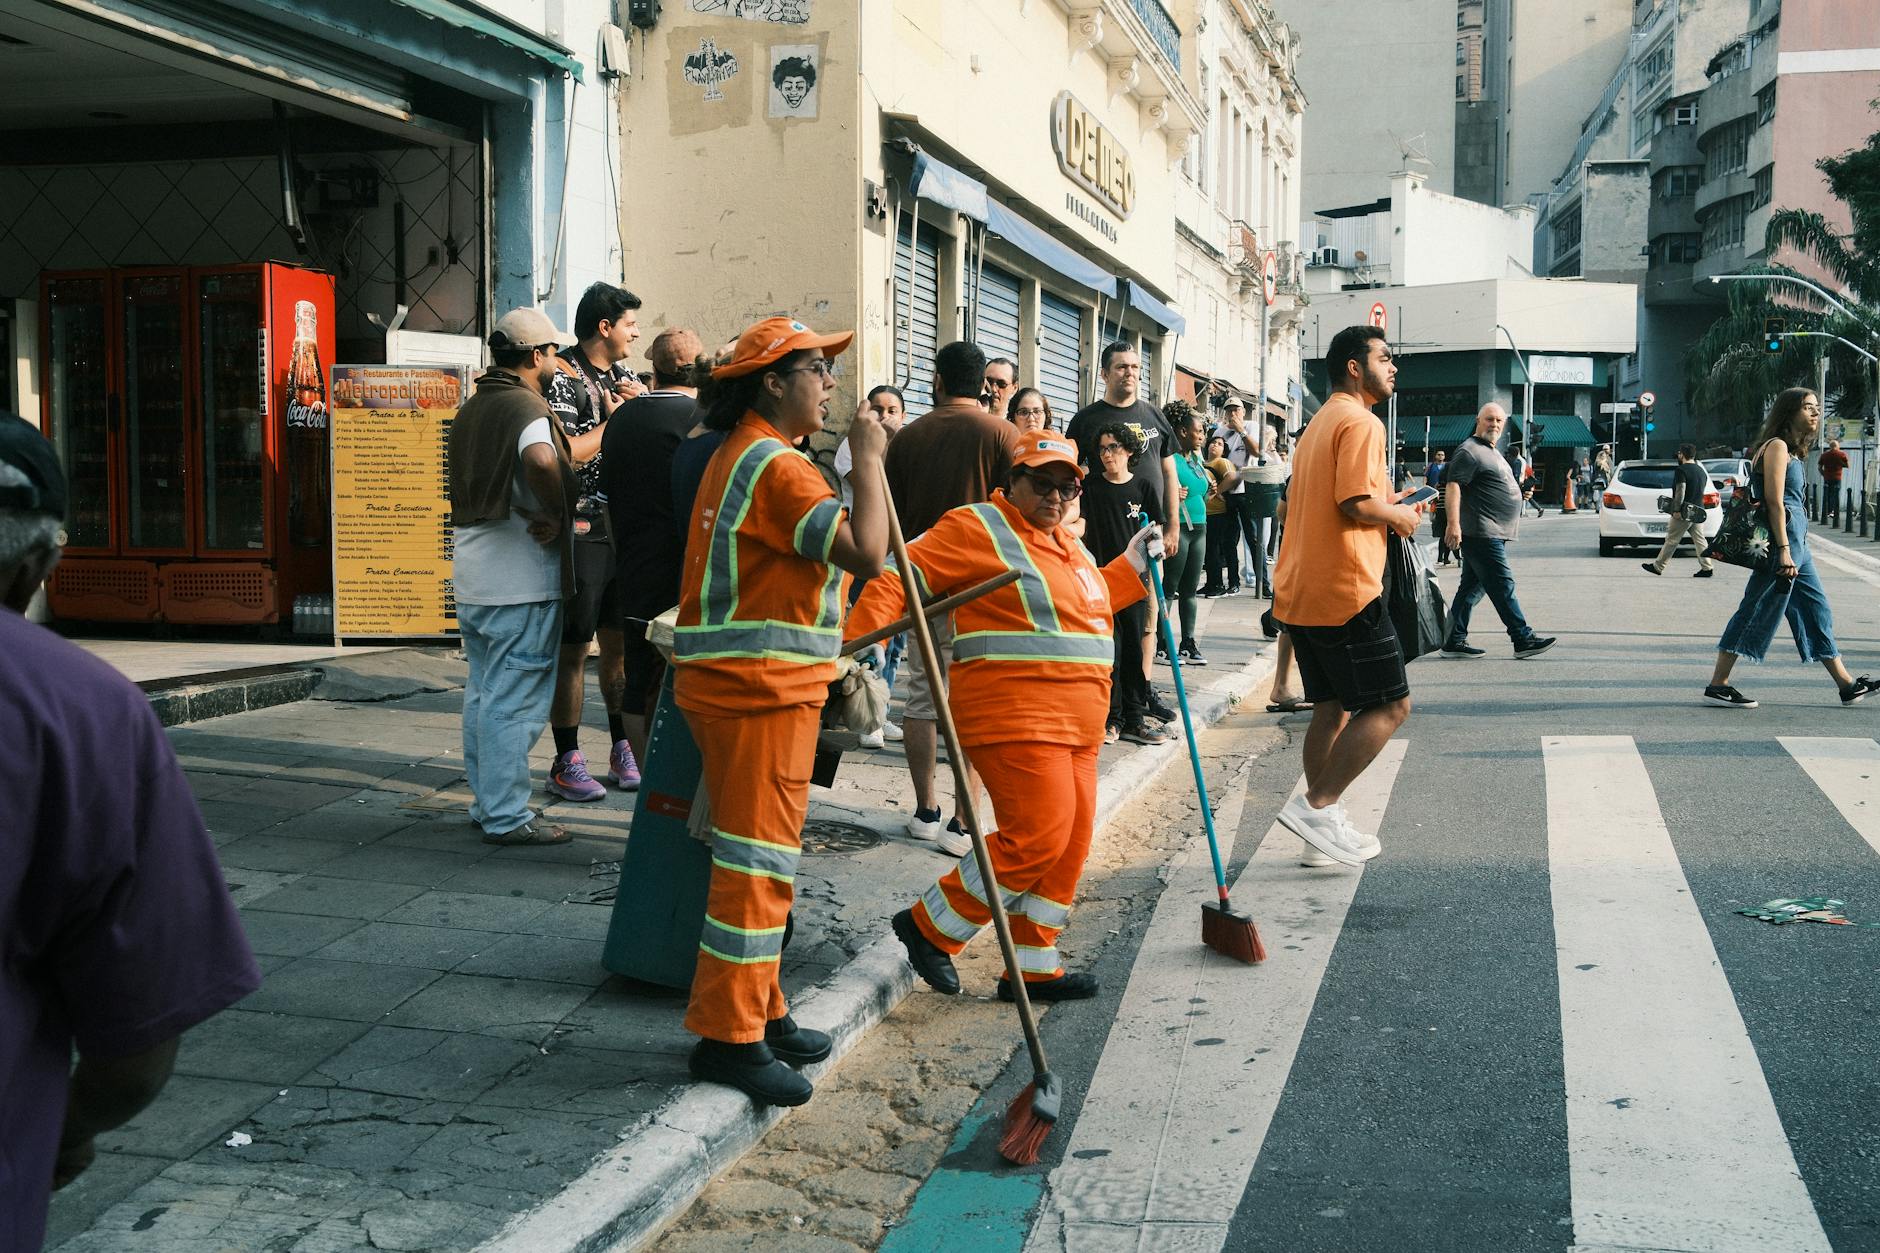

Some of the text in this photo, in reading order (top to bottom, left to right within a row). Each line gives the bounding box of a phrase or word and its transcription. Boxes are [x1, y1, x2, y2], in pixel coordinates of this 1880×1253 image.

[368, 409, 395, 418] Pratos
[365, 503, 391, 512] Pratos
[365, 567, 435, 576] Pratos Comerciais
